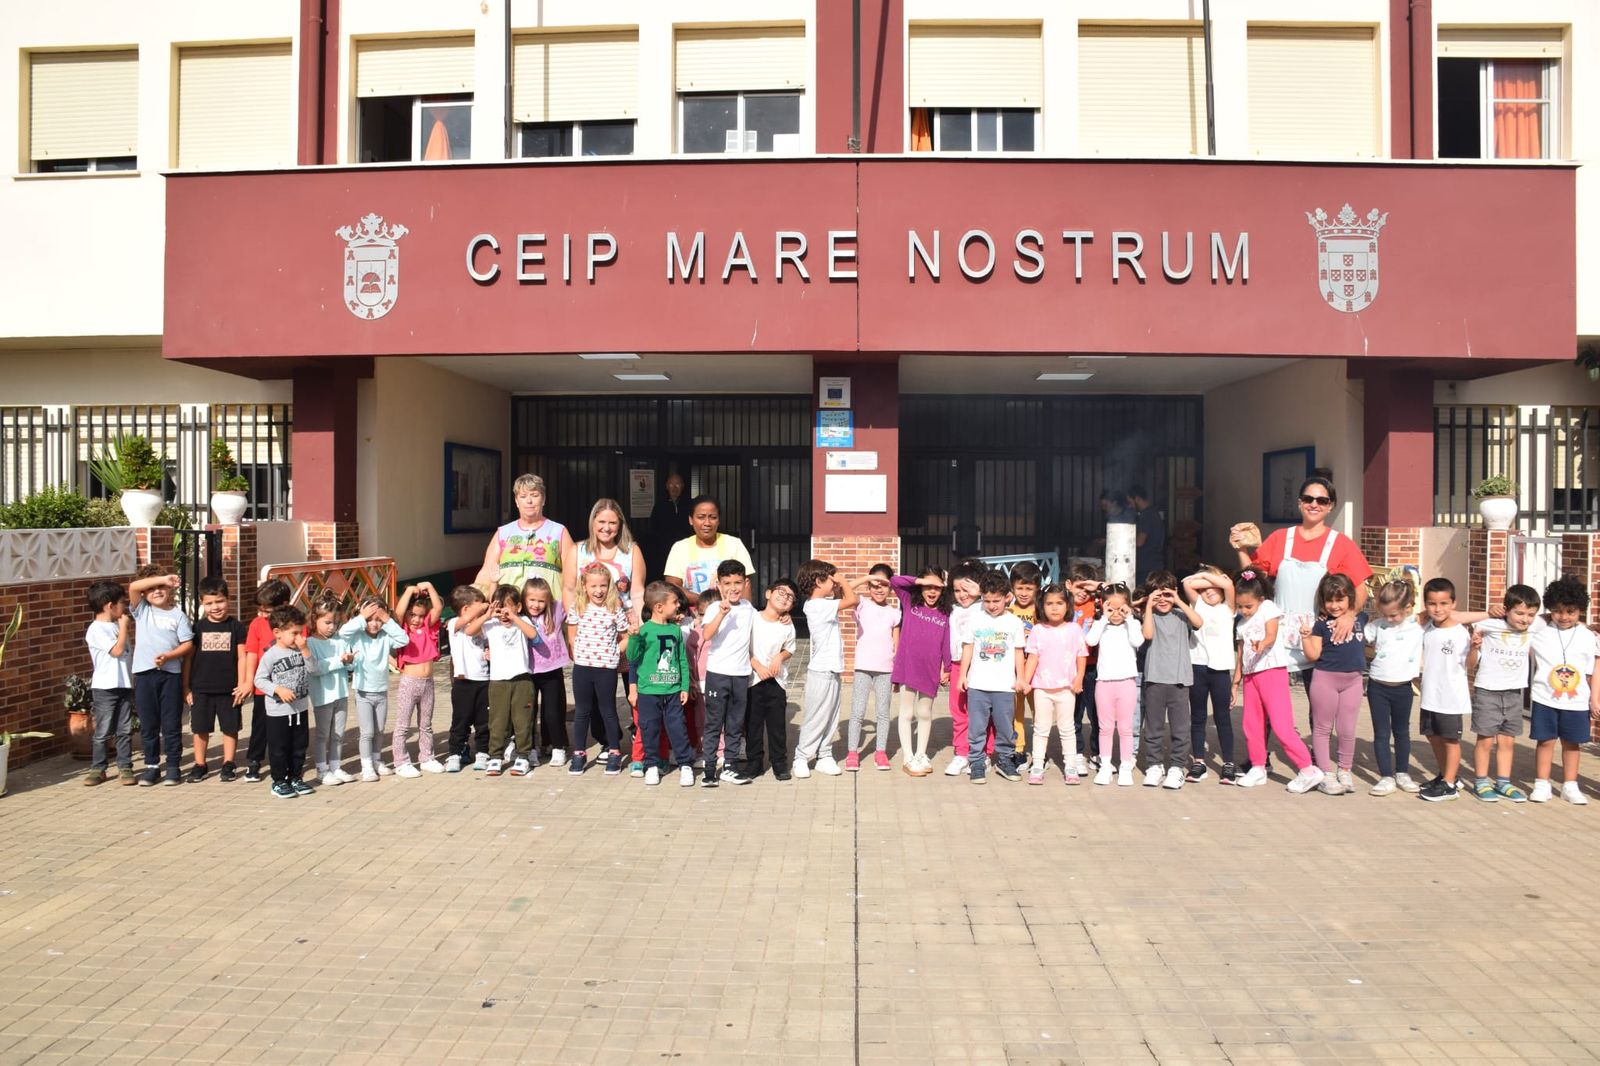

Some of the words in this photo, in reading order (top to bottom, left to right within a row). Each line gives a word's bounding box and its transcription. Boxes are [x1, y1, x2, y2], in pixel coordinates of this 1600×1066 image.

[465, 233, 618, 286] CEIP
[666, 229, 858, 285] MARE
[907, 229, 1250, 285] NOSTRUM
